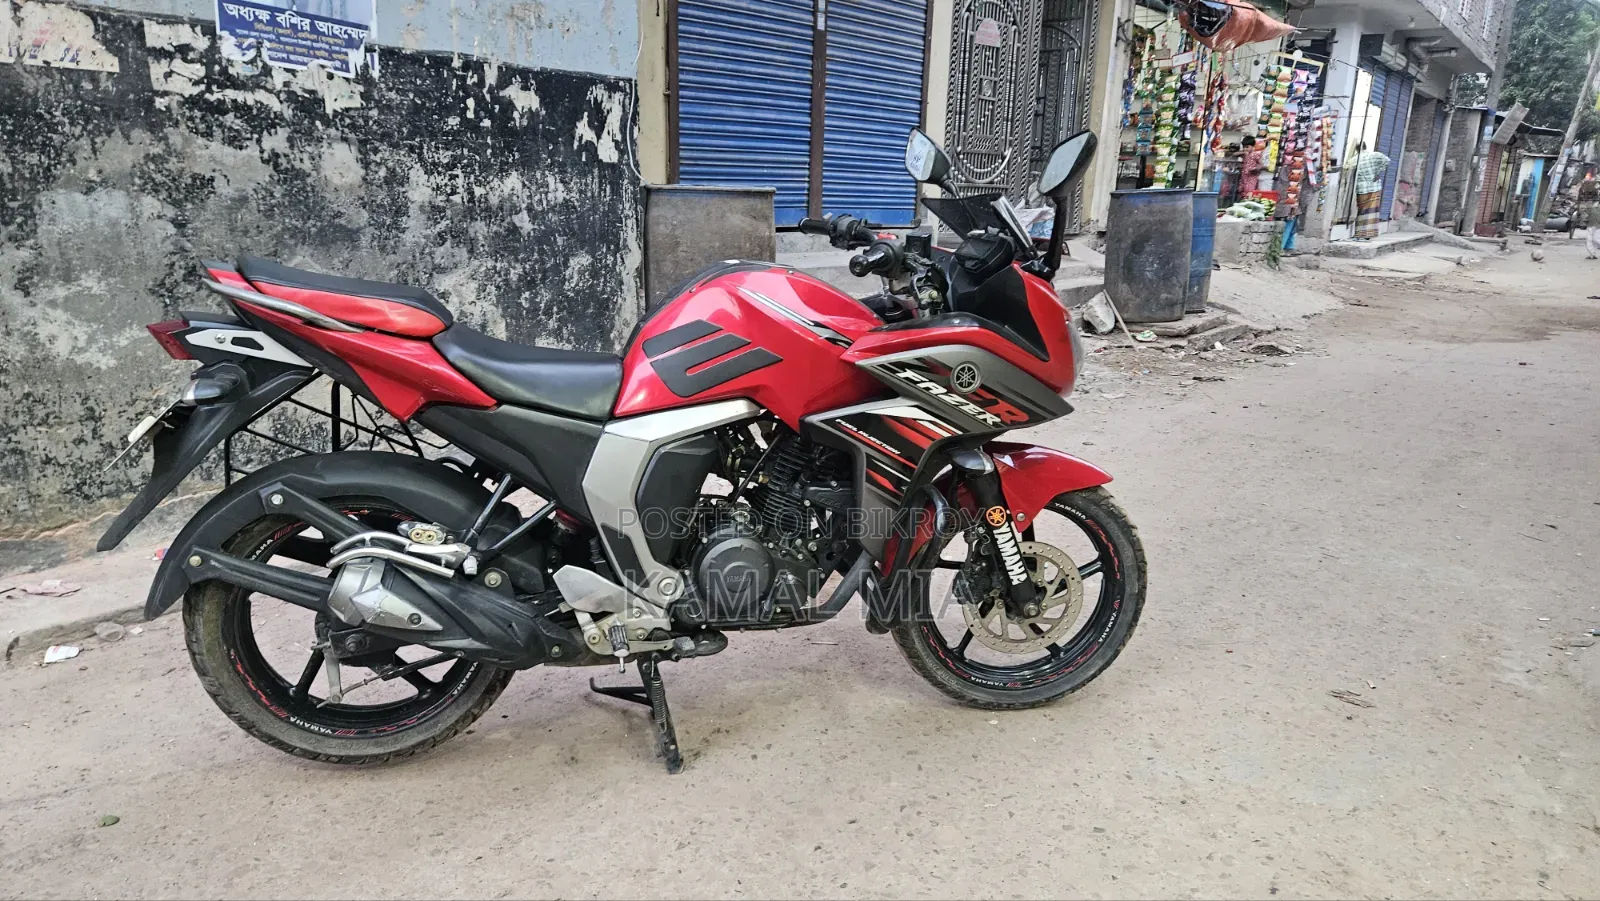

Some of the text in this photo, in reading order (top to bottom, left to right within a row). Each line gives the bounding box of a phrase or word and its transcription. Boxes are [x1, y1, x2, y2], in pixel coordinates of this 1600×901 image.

[222, 2, 272, 24] অধ্যক্ষ
[274, 10, 311, 32] বশির
[895, 367, 1002, 426] FAZER
[1054, 502, 1087, 520] YAMAHA
[992, 521, 1028, 586] YAMAHA
[1097, 610, 1117, 642] YAMAHA
[451, 661, 479, 695] YAMAHA
[970, 676, 1005, 687] YAMAHA
[290, 716, 332, 734] YAMAHA
